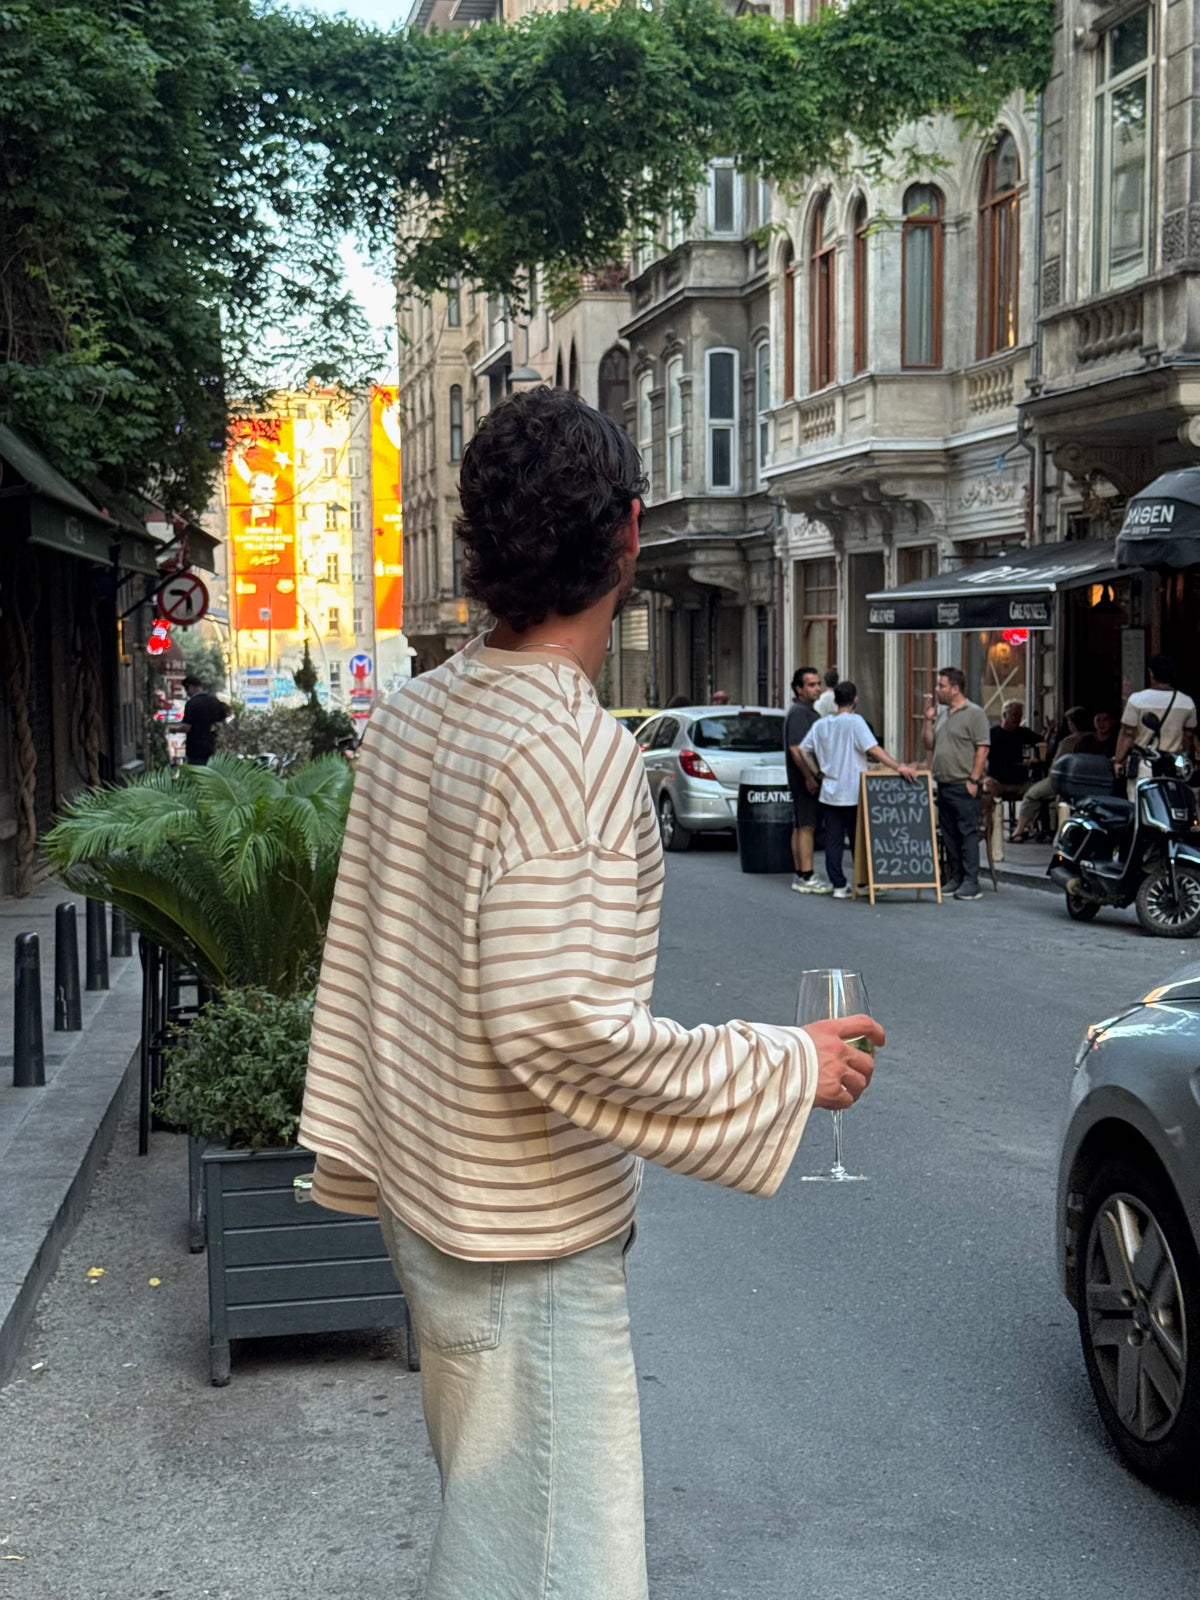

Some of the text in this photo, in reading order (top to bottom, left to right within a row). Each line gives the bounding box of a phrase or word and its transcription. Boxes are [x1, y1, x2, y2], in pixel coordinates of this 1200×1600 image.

[747, 790, 794, 804] GREATNE
[871, 805, 924, 825] SPAIN
[873, 838, 933, 857] AUSTRIA
[875, 858, 934, 876] 22:00
